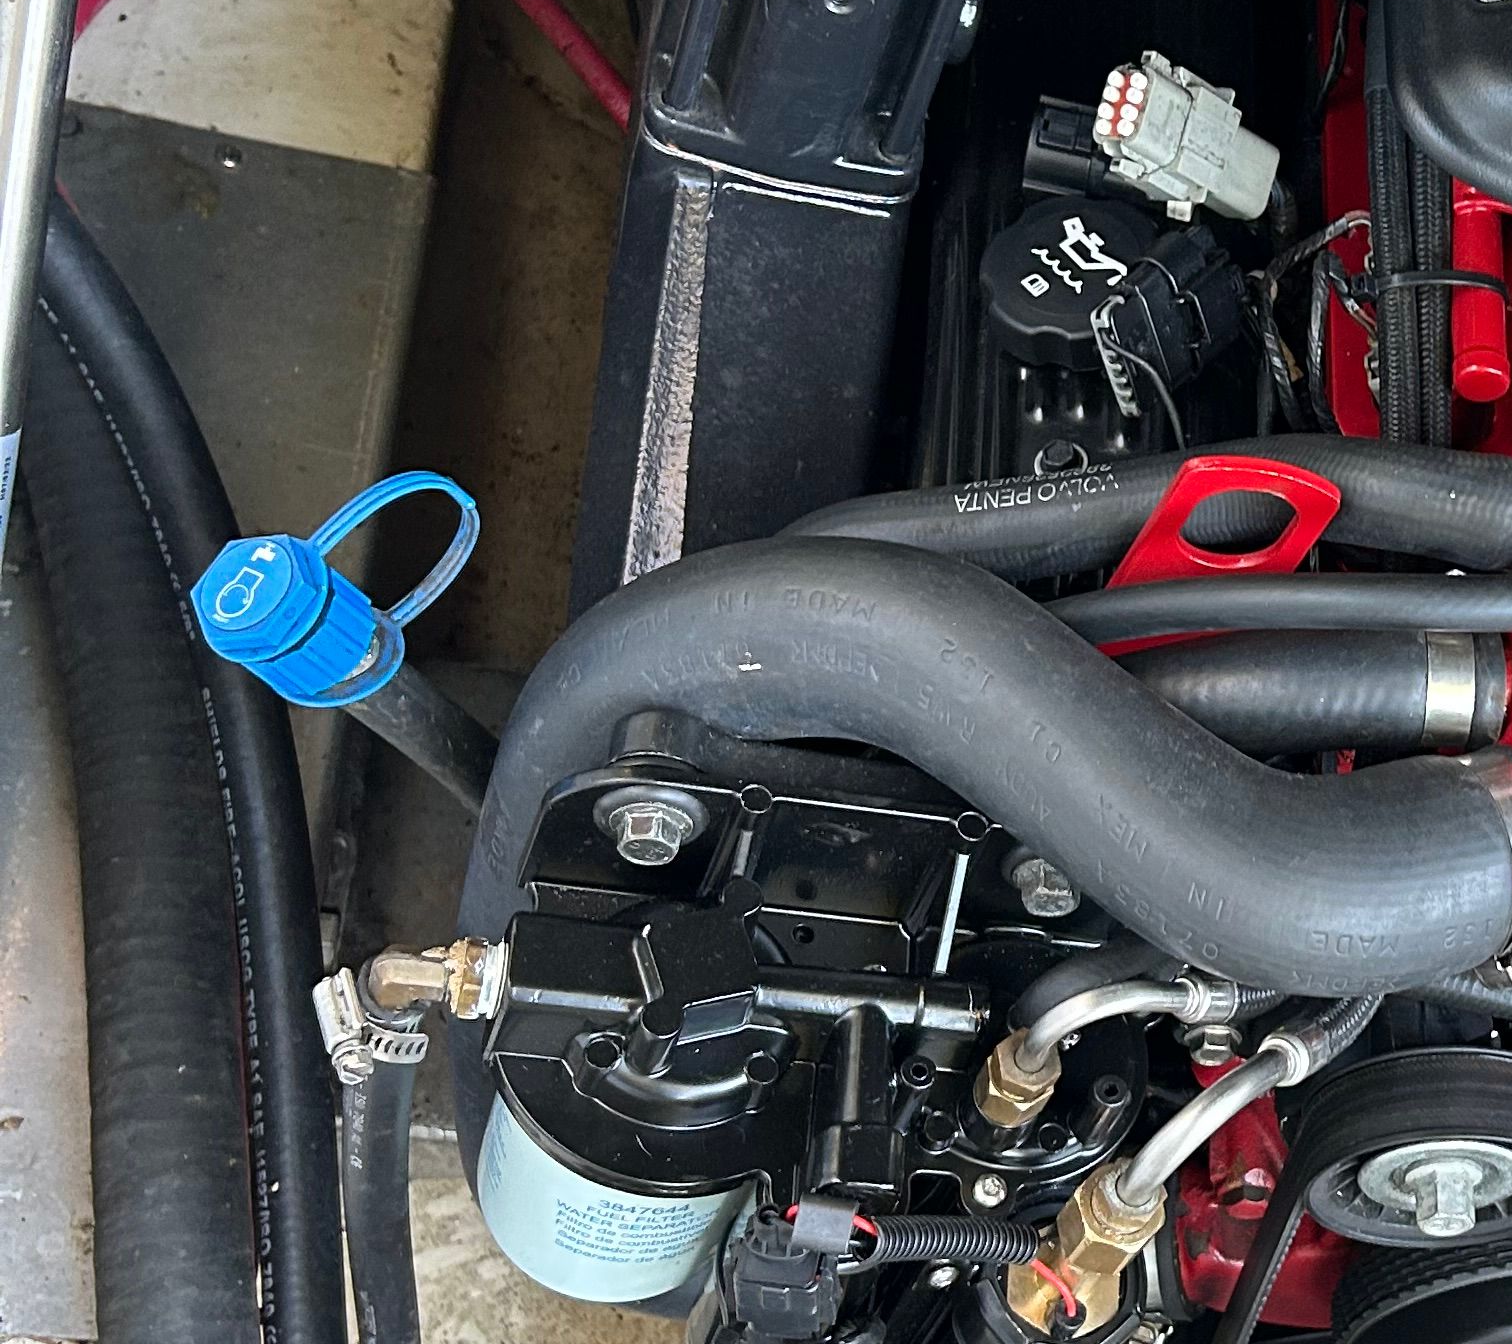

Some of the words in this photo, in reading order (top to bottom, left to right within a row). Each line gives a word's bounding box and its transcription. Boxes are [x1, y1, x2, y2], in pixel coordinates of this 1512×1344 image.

[954, 485, 1032, 513] PENTA
[556, 1198, 613, 1228] WATER
[617, 1208, 721, 1231] SEPARATOR
[586, 1205, 632, 1222] FUEL
[634, 1210, 695, 1223] FILTER
[599, 1199, 690, 1216] 3847644
[555, 1218, 591, 1239] Filtro
[594, 1236, 614, 1244] de
[556, 1209, 593, 1231] Filtro
[596, 1227, 617, 1237] de
[554, 1238, 631, 1264] Separador
[634, 1255, 655, 1264] de
[557, 1229, 635, 1255] Separador
[638, 1246, 659, 1255] de
